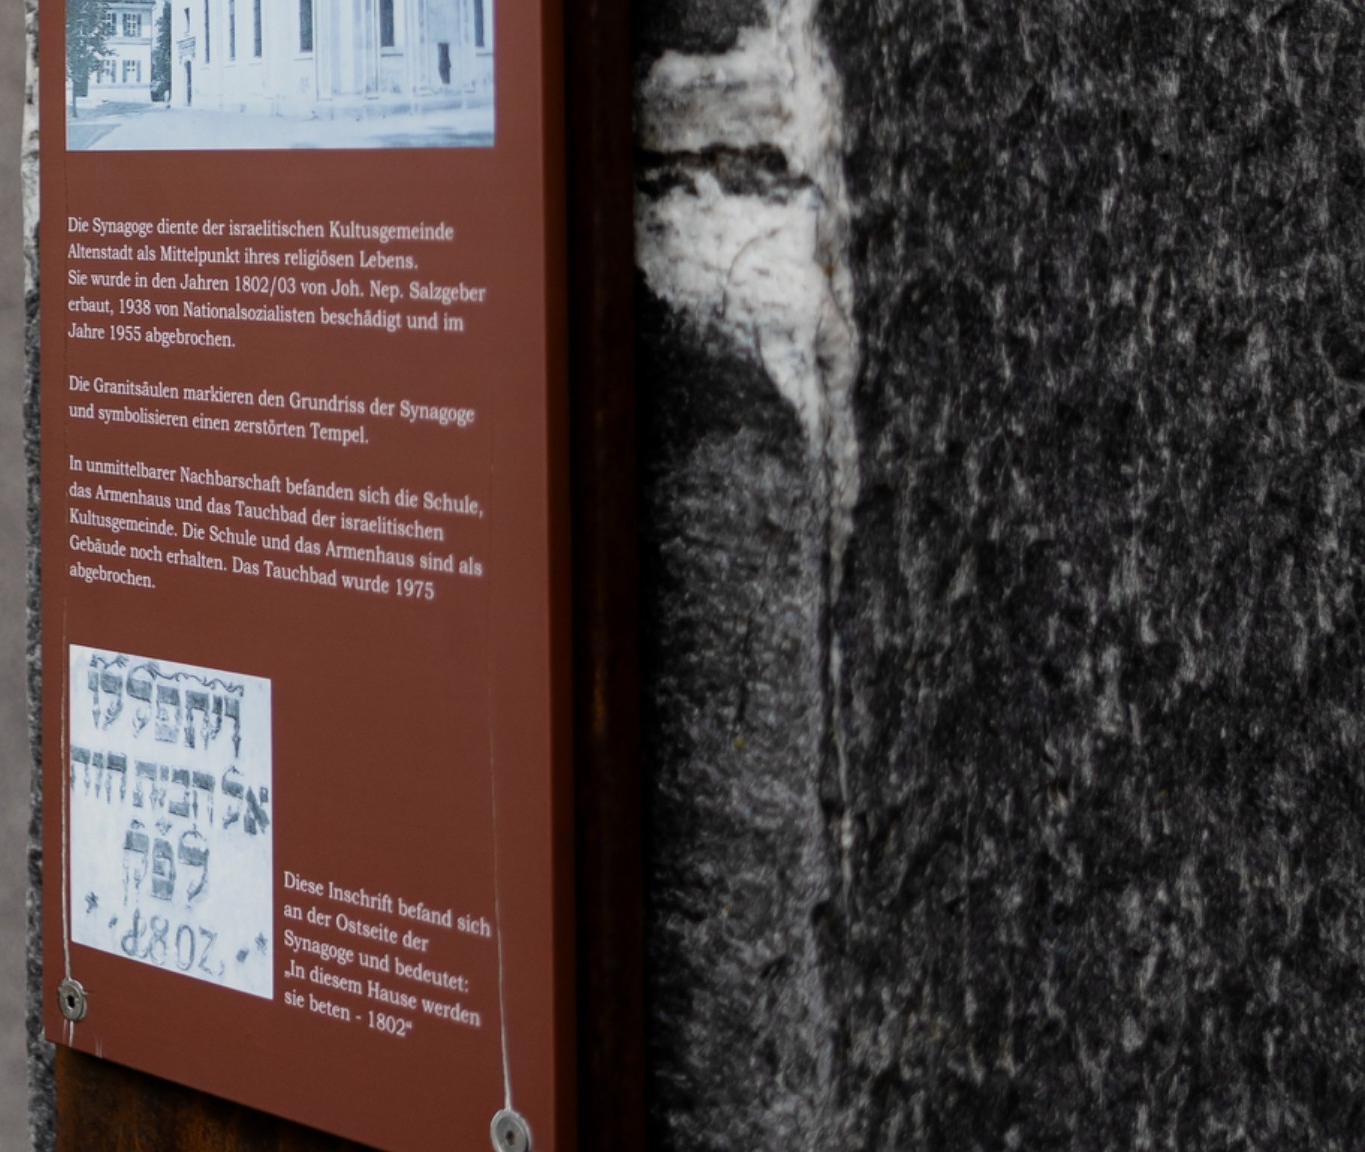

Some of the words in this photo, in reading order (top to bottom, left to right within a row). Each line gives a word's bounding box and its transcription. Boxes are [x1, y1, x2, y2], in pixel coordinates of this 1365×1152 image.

[68, 216, 89, 233] Die
[92, 217, 154, 238] Synagoge
[156, 217, 199, 235] diente
[202, 218, 226, 236] der
[229, 219, 325, 238] israelitischen
[329, 220, 454, 243] Kultusgemeinde
[67, 242, 134, 261] Altenstadt
[136, 244, 156, 261] als
[160, 245, 241, 267] Mittelpunkt
[244, 247, 280, 265] ihres
[284, 248, 355, 271] religiösen
[359, 250, 418, 270] Lebens.
[68, 269, 88, 286] Sie
[90, 271, 132, 288] wurde
[134, 271, 148, 288] in
[151, 272, 177, 289] den
[179, 273, 229, 291] Jahren
[235, 275, 296, 297] 1802/03
[300, 282, 327, 296] von
[330, 278, 364, 297] Joh.
[370, 280, 404, 303] Nep.
[409, 280, 487, 305] Salzgeber
[67, 322, 105, 340] Jahre
[110, 325, 142, 342] 1955
[144, 326, 236, 348] abgebrochen.
[68, 296, 114, 316] erbaut,
[119, 298, 151, 315] 1938
[154, 304, 179, 317] von
[183, 301, 316, 324] Nationalsozialisten
[320, 306, 402, 333] beschädigt
[406, 312, 439, 331] und
[443, 313, 465, 332] im
[68, 403, 95, 419] und
[98, 406, 189, 428] symbolisieren
[192, 412, 230, 432] einen
[234, 419, 306, 439] zerstörten
[309, 422, 369, 447] Tempel.
[69, 375, 91, 392] Die
[93, 377, 180, 399] Granitsäulen
[183, 385, 254, 405] markieren
[258, 389, 285, 408] den
[289, 391, 366, 415] Grundriss
[369, 397, 396, 417] der
[400, 399, 475, 428] Synagoge
[69, 454, 83, 471] In
[85, 459, 177, 482] unmittelbarer
[180, 466, 282, 493] Nachbarschaft
[285, 476, 354, 501] befanden
[358, 485, 390, 505] sich
[394, 488, 419, 508] die
[423, 491, 484, 519] Schule,
[68, 481, 92, 499] das
[95, 484, 172, 509] Armenhaus
[175, 495, 203, 512] und
[206, 497, 232, 516] das
[234, 500, 308, 525] Tauchbad
[311, 509, 337, 528] der
[340, 512, 445, 542] israelitischen
[69, 507, 178, 537] Kultusgemeinde.
[182, 521, 205, 540] Die
[209, 525, 257, 547] Schule
[261, 534, 291, 552] und
[294, 536, 321, 556] das
[325, 540, 415, 568] Armenhaus
[419, 552, 454, 574] sind
[458, 556, 484, 577] als
[69, 534, 127, 557] Gebäude
[129, 545, 163, 562] noch
[166, 548, 227, 571] erhalten.
[232, 556, 260, 576] Das
[263, 560, 337, 587] Tauchbad
[341, 575, 390, 594] wurde
[396, 578, 435, 601] 1975
[69, 561, 156, 589] abgebrochen.
[283, 904, 303, 921] an
[306, 906, 332, 928] der
[335, 913, 398, 944] Ostseite
[402, 930, 429, 952] der
[284, 870, 324, 896] Diese
[328, 881, 393, 914] Inschrift
[397, 897, 453, 929] befand
[457, 913, 492, 938] sich
[284, 929, 355, 966] Synagoge
[358, 952, 390, 973] und
[394, 957, 469, 993] bedeutet:
[284, 989, 305, 1008] sie
[309, 993, 351, 1022] beten
[309, 965, 363, 995] diesem
[367, 980, 417, 1010] Hause
[421, 999, 481, 1028] werden
